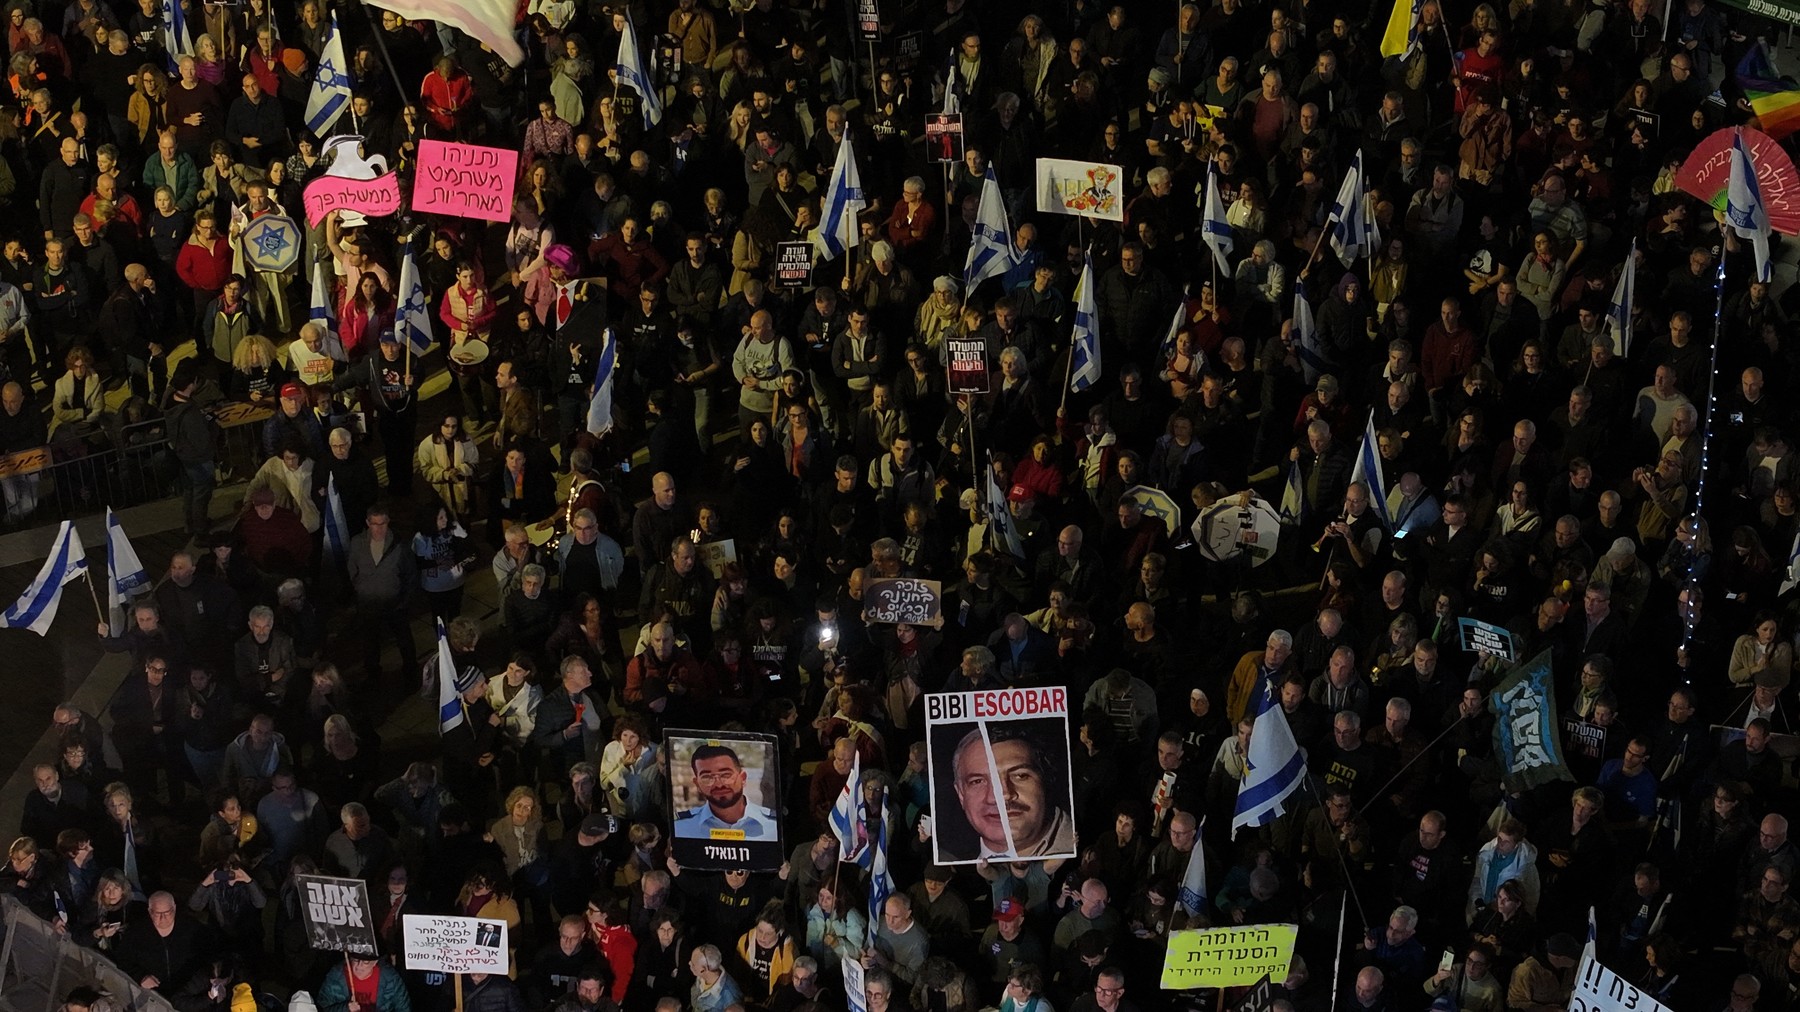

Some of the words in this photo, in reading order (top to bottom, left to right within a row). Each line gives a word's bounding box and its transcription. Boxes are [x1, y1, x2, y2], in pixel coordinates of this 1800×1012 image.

[443, 147, 498, 168] נתניהו
[427, 166, 503, 191] משתמט
[338, 187, 392, 204] ממשלה
[426, 187, 503, 213] מאחריות
[777, 262, 810, 270] ממלכתית
[782, 254, 807, 263] חקירה
[948, 341, 984, 351] ממשלת
[954, 351, 980, 361] הטבח
[880, 589, 934, 604] בחנינה
[929, 694, 967, 719] BIBI
[974, 689, 1065, 717] ESCOBAR
[704, 845, 738, 861] גואילי
[739, 847, 750, 862] רן
[307, 882, 358, 907] אתה
[308, 902, 364, 928] אשם
[432, 920, 467, 929] נתניהו
[1199, 930, 1269, 946] היוזמה
[465, 948, 480, 956] לא
[1186, 946, 1278, 962] הסעודית
[1169, 967, 1221, 976] היחידי
[1233, 963, 1286, 976] הפתרון
